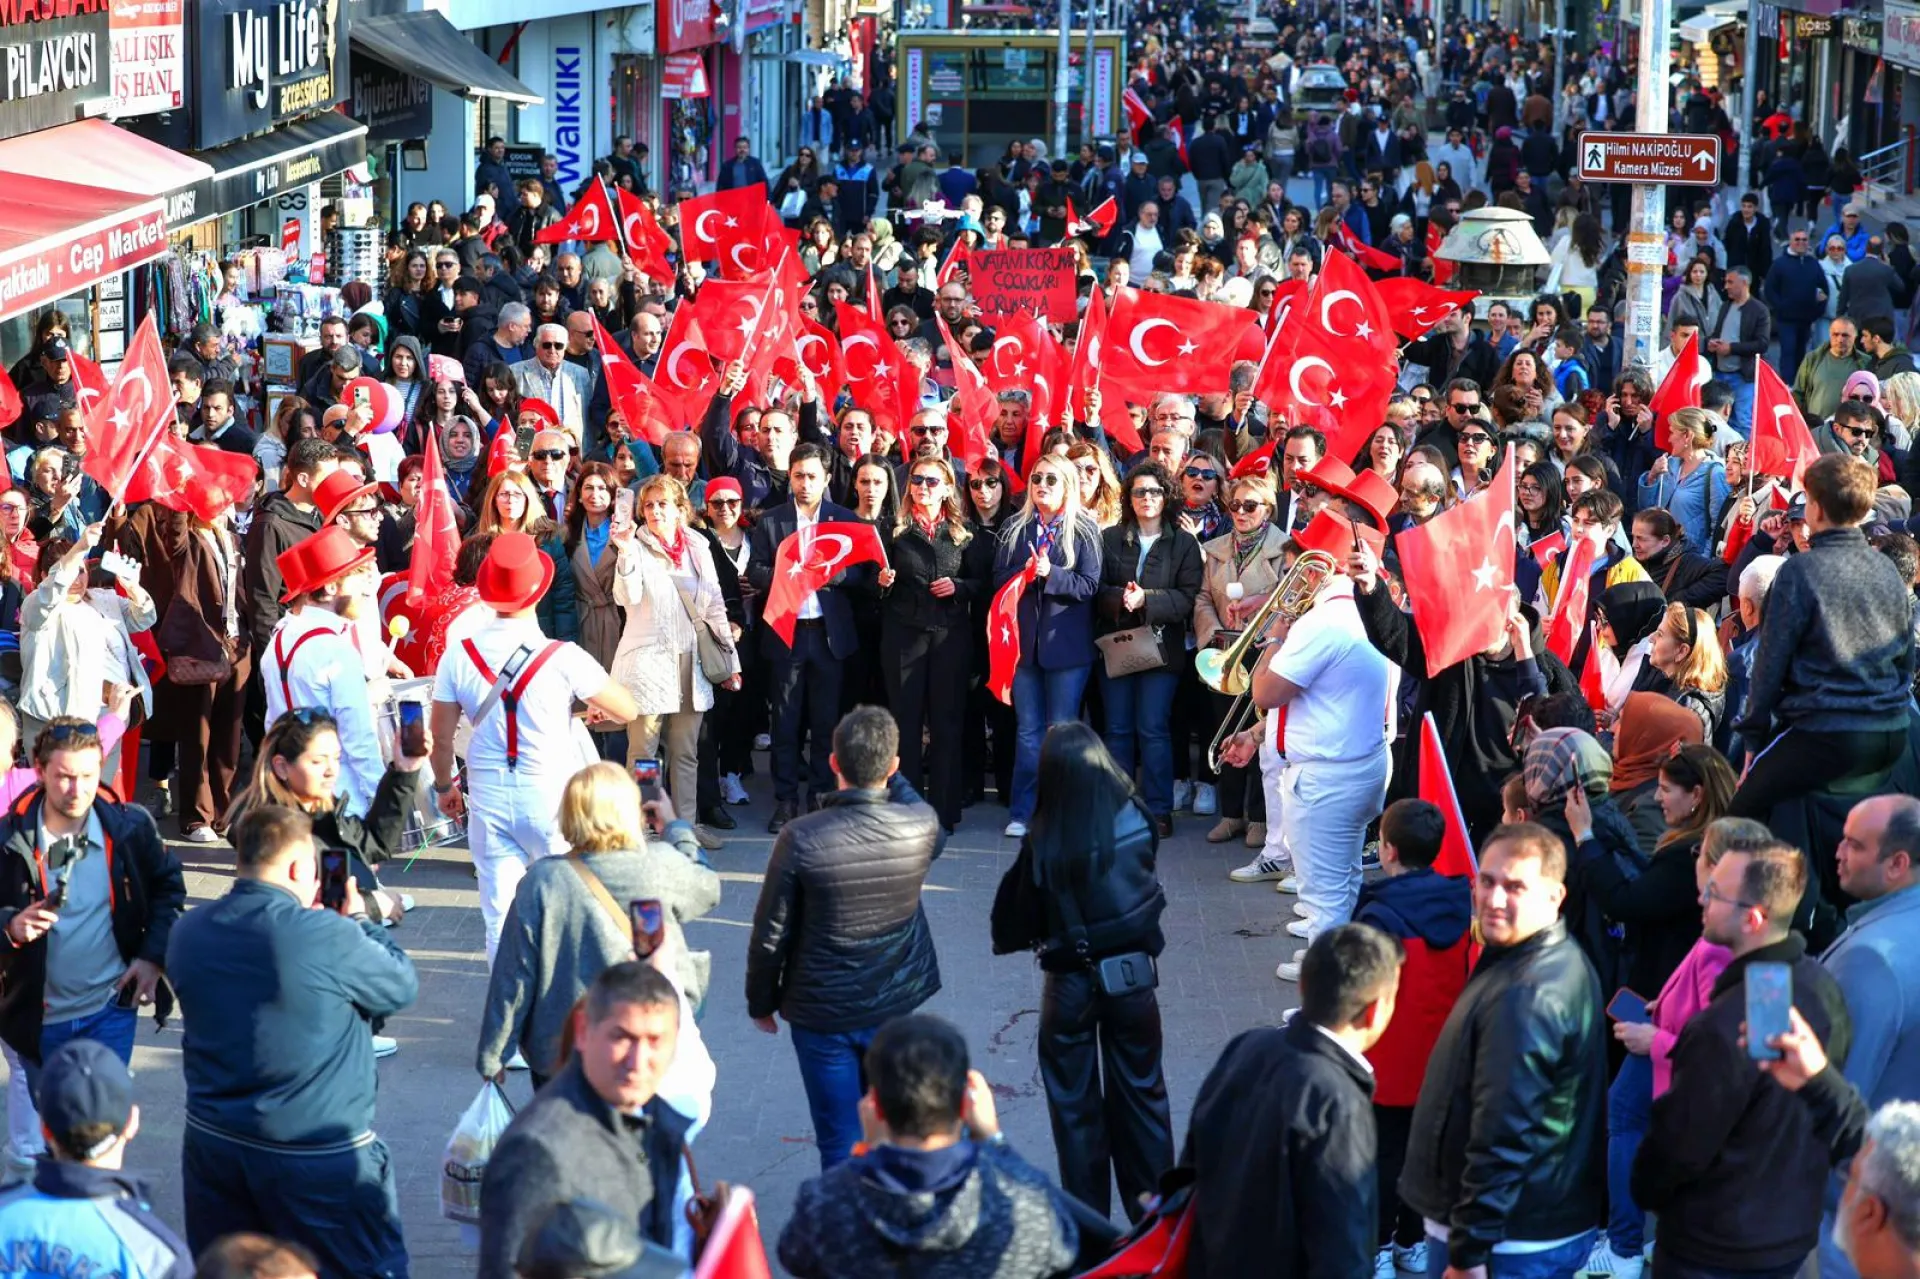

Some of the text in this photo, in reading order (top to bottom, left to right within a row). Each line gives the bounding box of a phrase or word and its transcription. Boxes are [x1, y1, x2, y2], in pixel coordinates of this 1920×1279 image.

[113, 30, 175, 66] ALİ IŞIK
[233, 0, 319, 109] My Life
[134, 70, 173, 97] HANI
[281, 74, 330, 114] accessories
[1606, 139, 1692, 158] Hilmi NAKİPOĞLU
[1614, 160, 1682, 176] Kamera Müzesi
[70, 243, 104, 275] Cep
[108, 212, 164, 261] Market
